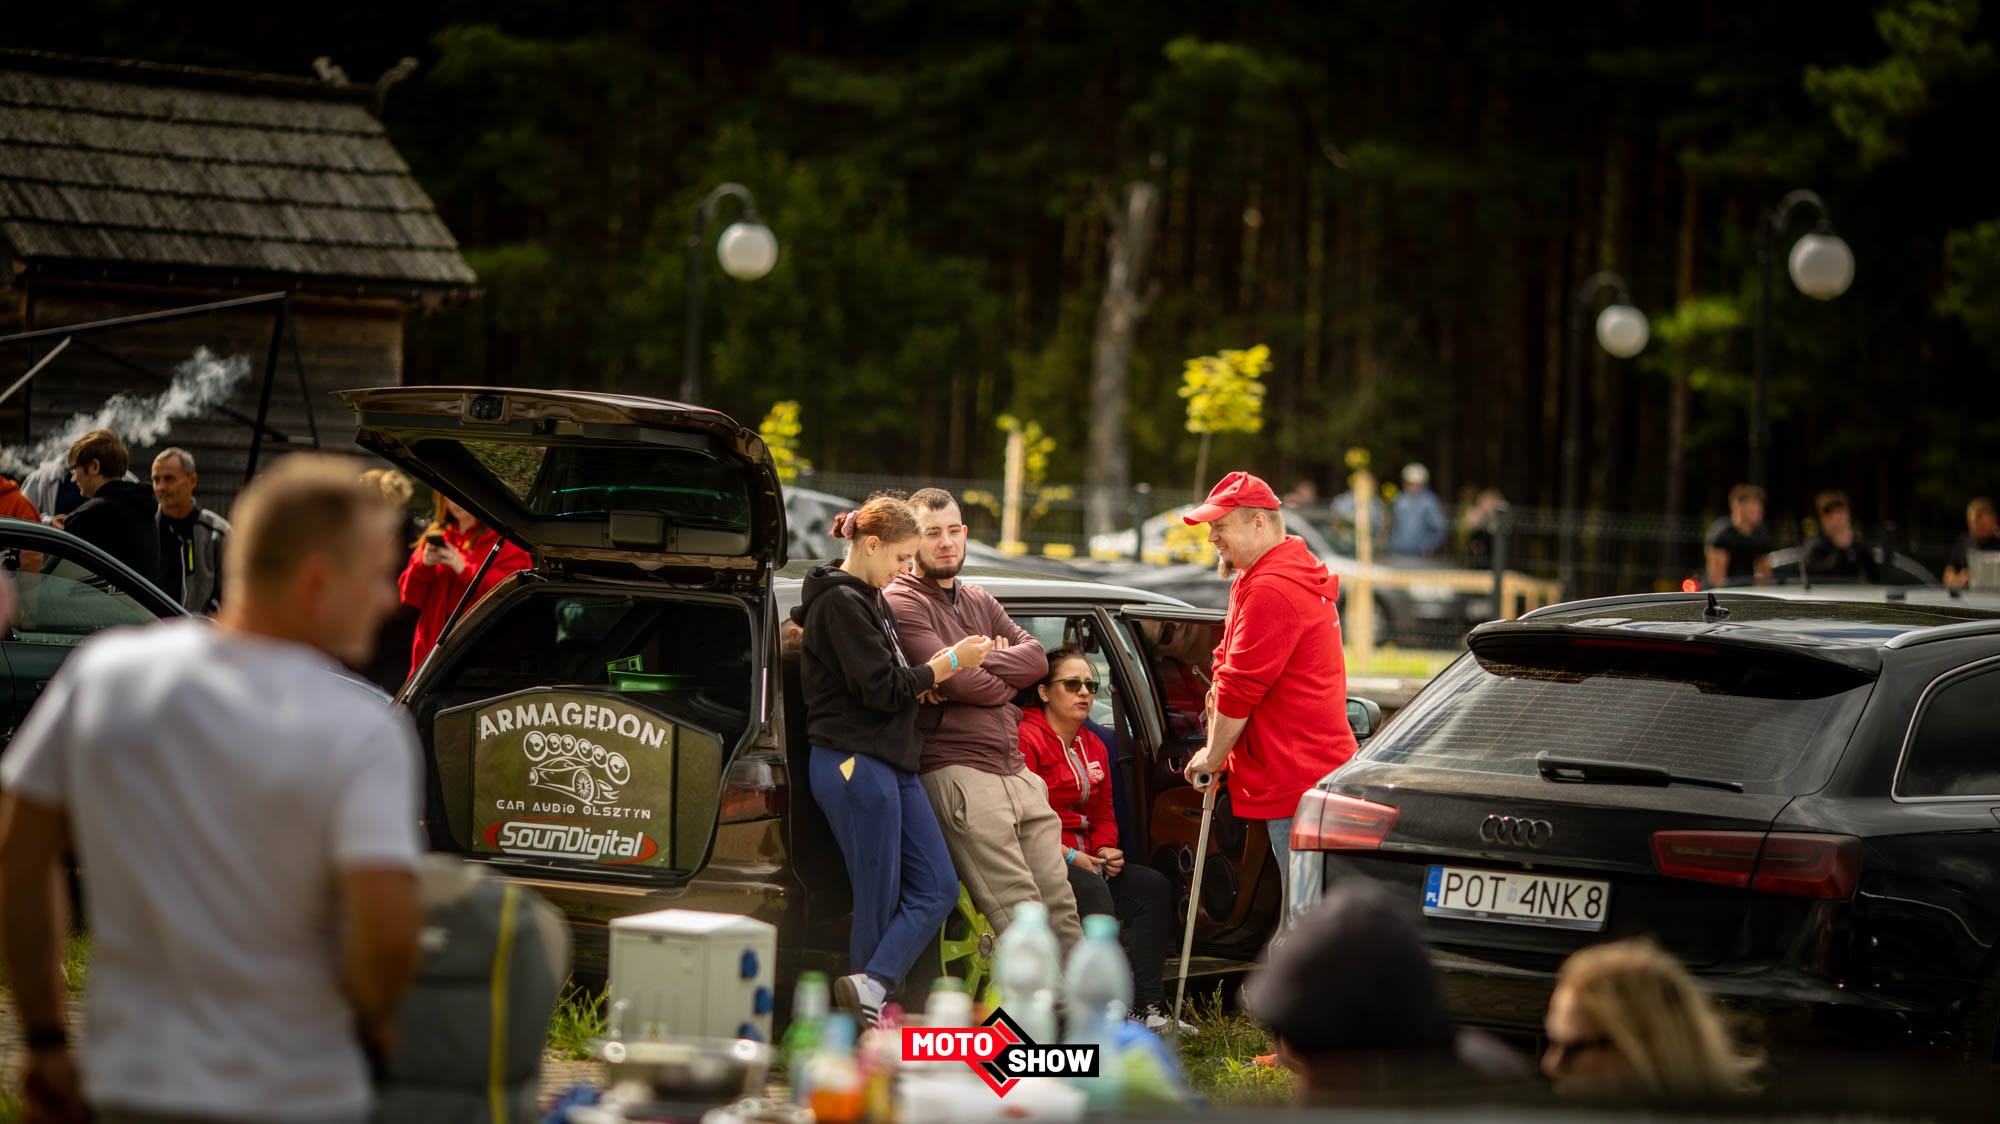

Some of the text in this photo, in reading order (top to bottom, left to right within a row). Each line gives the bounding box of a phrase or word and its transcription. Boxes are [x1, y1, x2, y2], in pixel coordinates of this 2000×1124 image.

[480, 703, 666, 748] ARMAGEDON
[496, 799, 525, 811] CAR
[1426, 892, 1437, 902] PL
[1443, 872, 1603, 919] POT 4NK8
